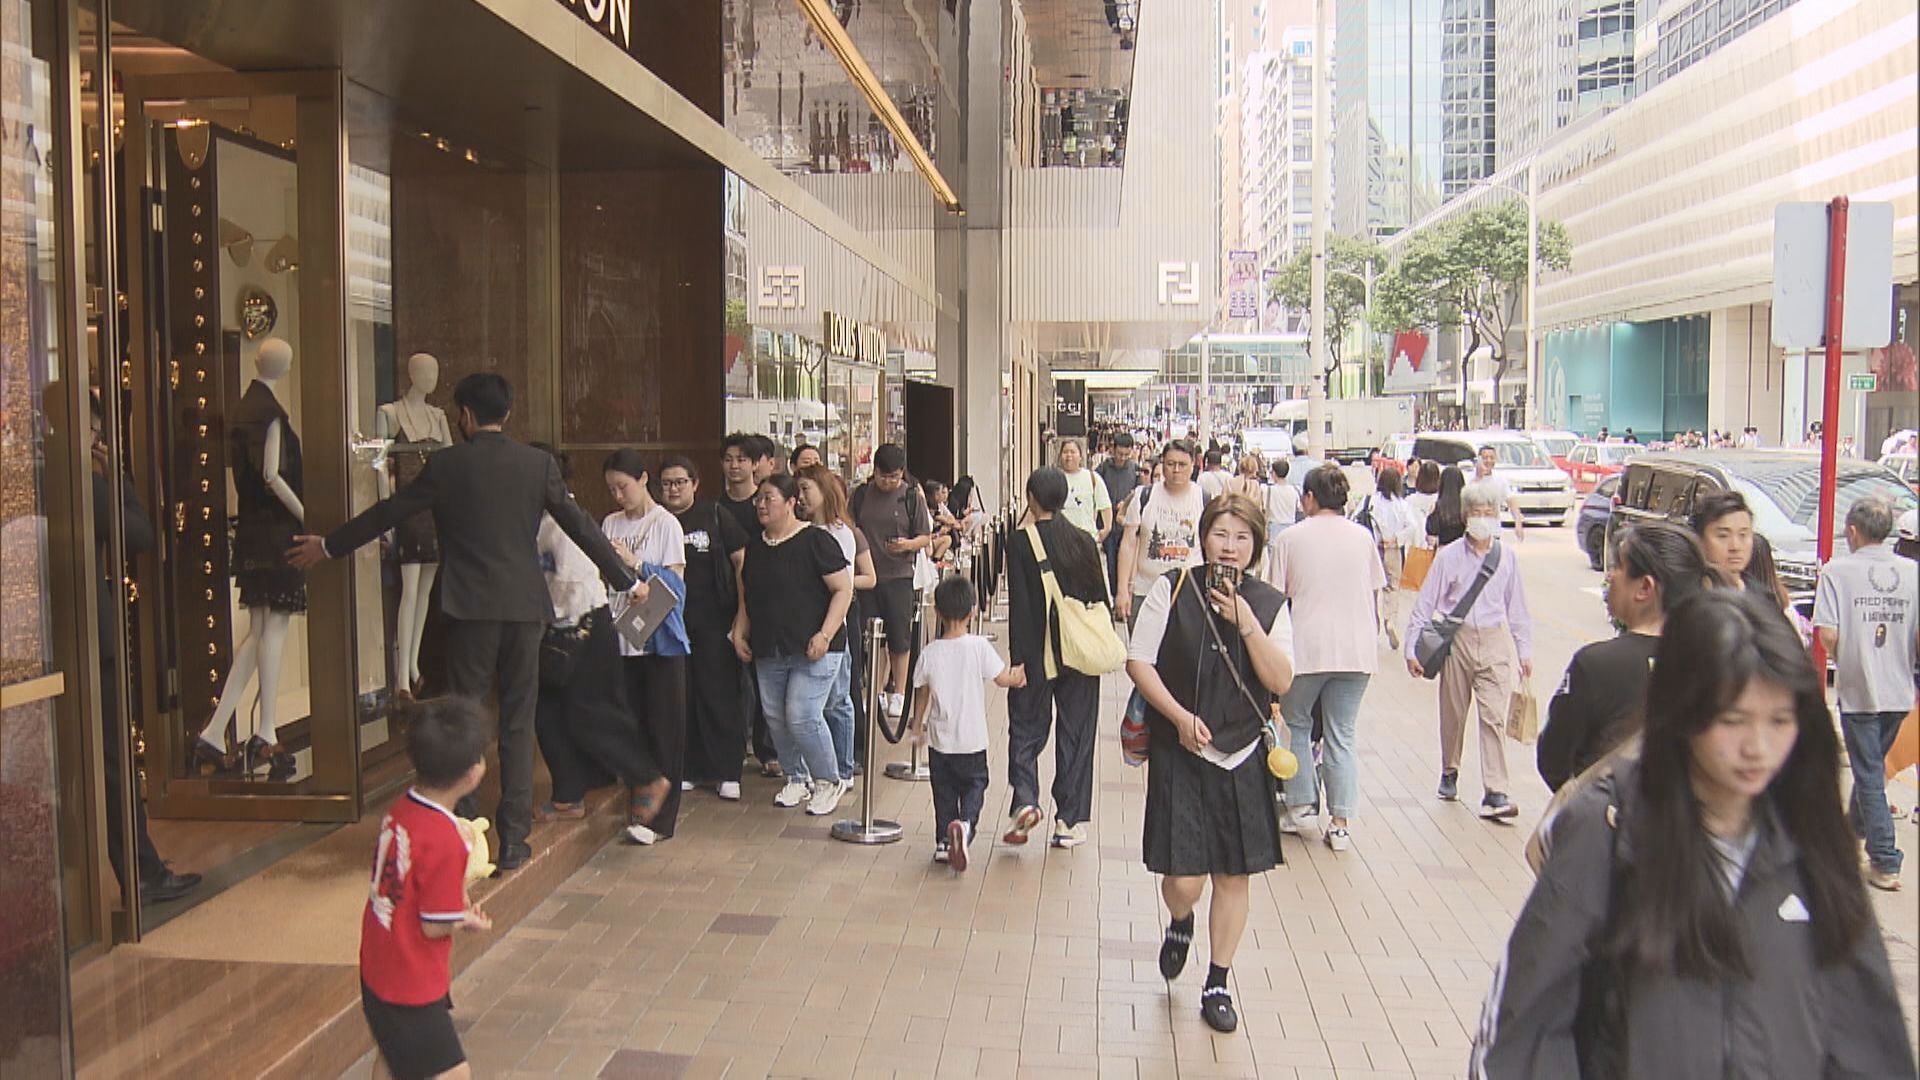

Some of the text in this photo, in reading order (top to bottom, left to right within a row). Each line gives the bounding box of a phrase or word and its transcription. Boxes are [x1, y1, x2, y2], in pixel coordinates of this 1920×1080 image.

[830, 308, 887, 368] LOUIS VUITTON
[1854, 596, 1881, 607] FRED
